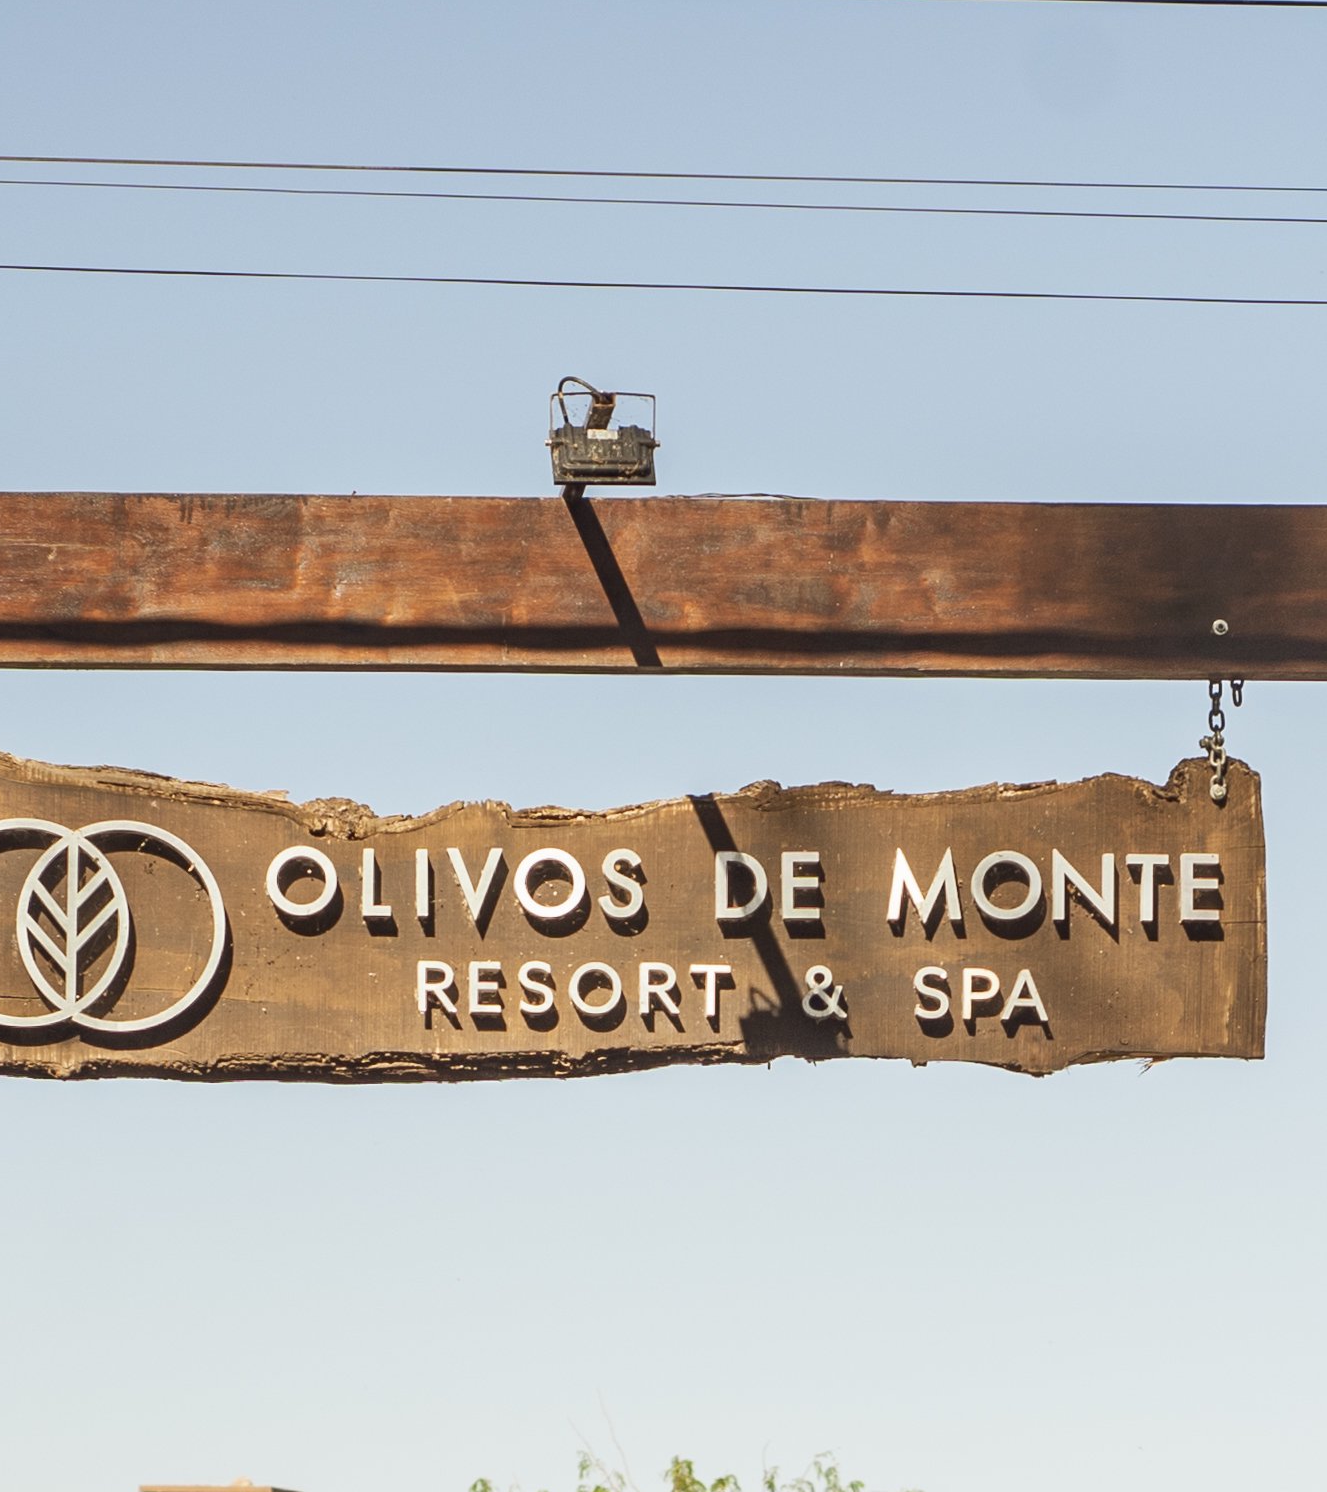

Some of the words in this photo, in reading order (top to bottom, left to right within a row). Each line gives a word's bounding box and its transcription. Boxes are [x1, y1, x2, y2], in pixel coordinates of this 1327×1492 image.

[266, 845, 644, 923] OLIVOS
[715, 850, 821, 920] DE
[886, 846, 1221, 926] MONTE
[416, 960, 732, 1017] RESORT
[802, 964, 848, 1020] &
[914, 965, 1049, 1022] SPA
